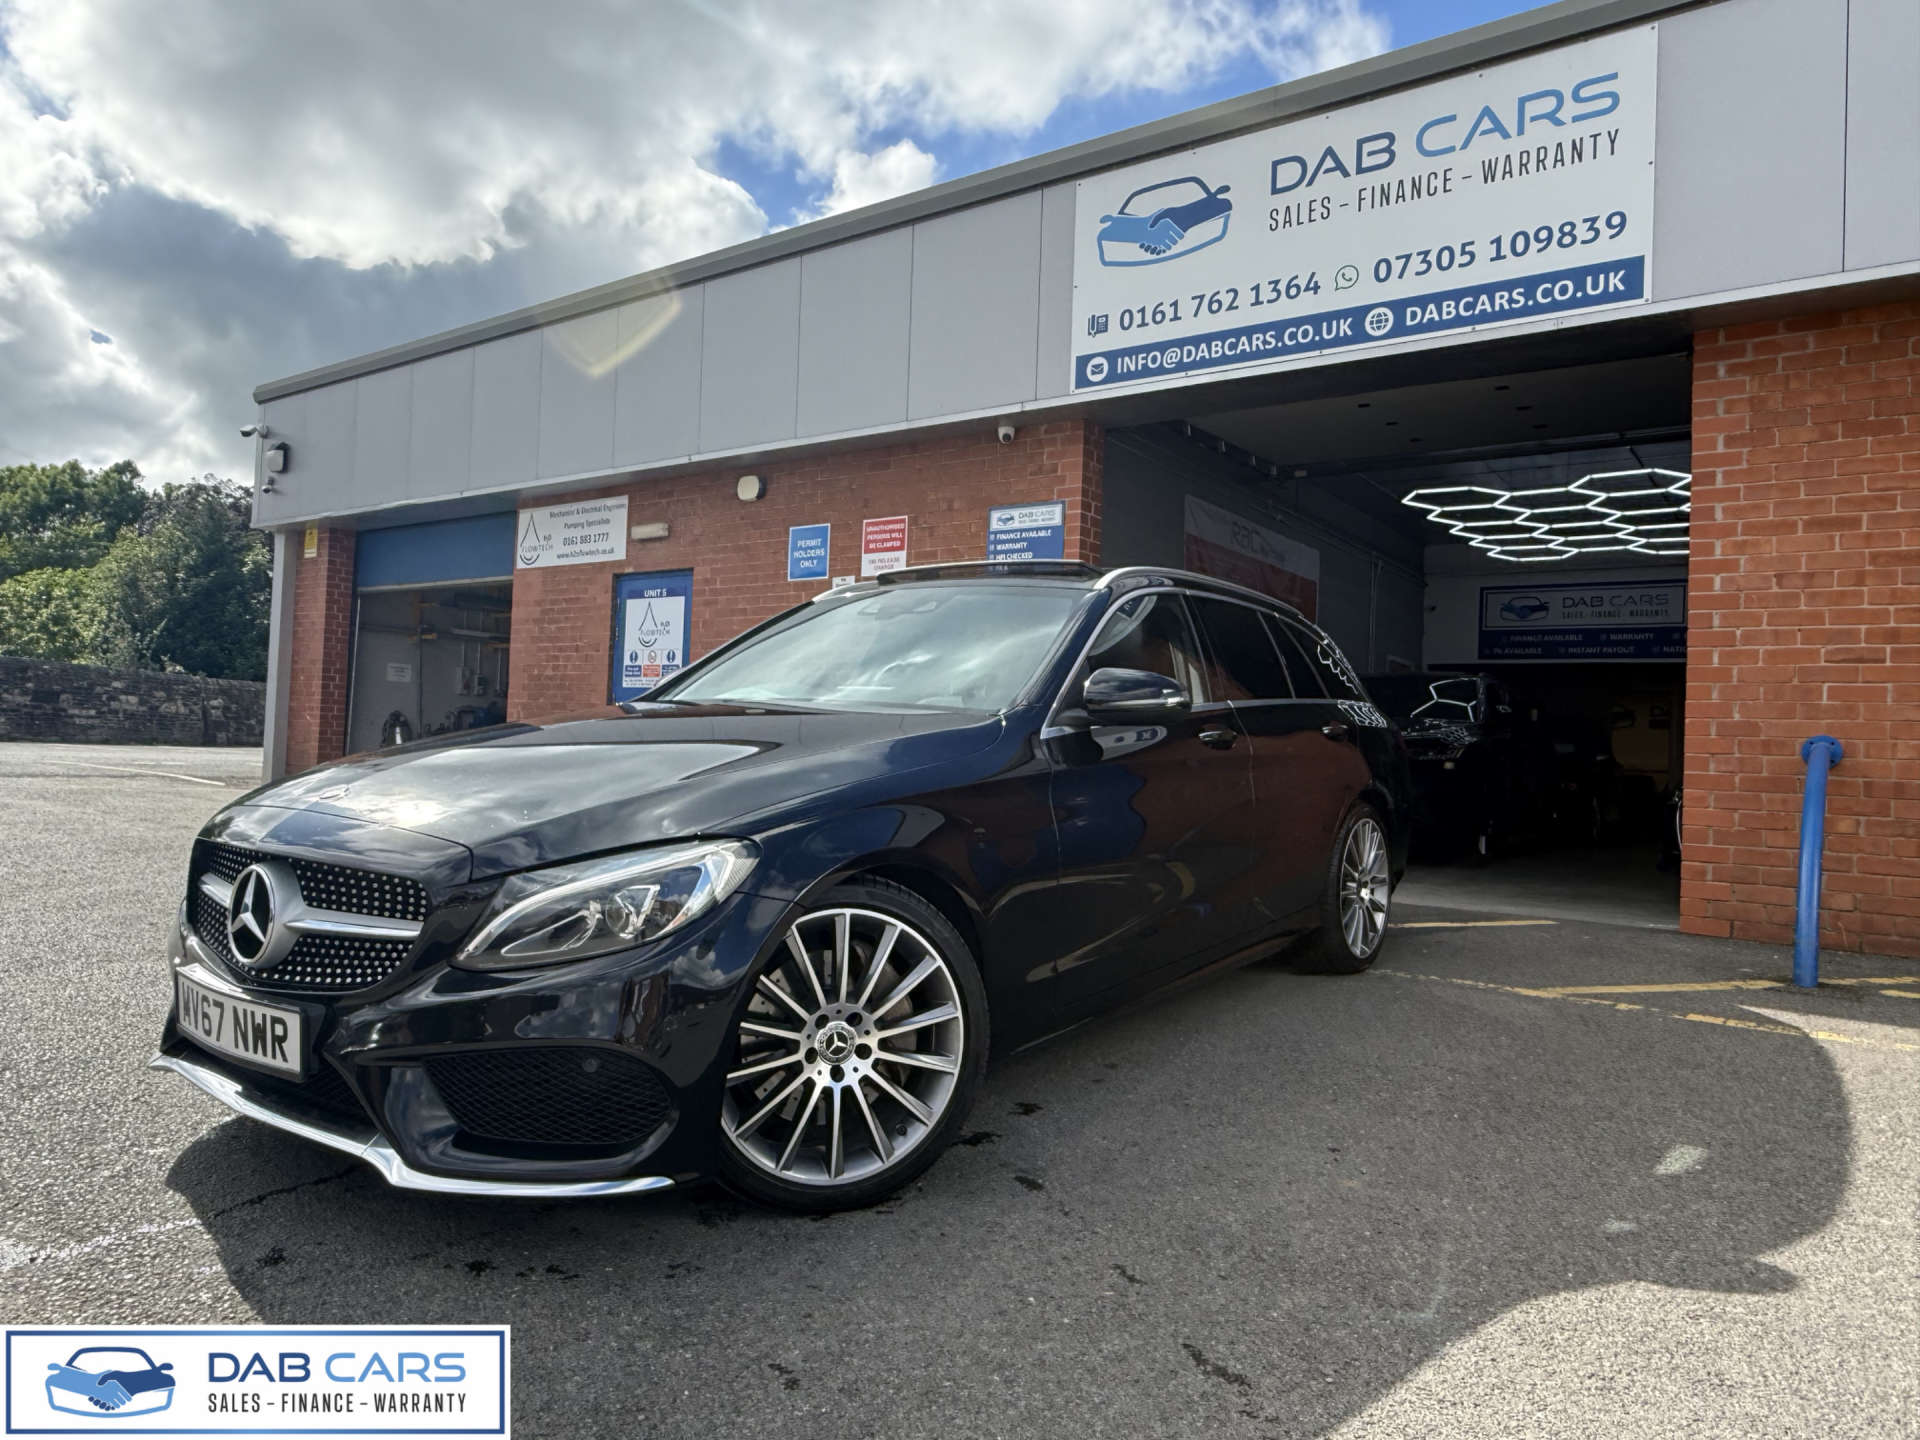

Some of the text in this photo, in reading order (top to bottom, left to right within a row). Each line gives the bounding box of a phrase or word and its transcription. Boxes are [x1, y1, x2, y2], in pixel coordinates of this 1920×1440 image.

[1270, 71, 1621, 196] DAB CARS
[1269, 195, 1332, 232] SALES
[1357, 167, 1453, 213] FINANCE
[1481, 128, 1621, 185] WARRANTY
[1373, 210, 1627, 285] 07305 109839
[1119, 271, 1321, 332] 0161 762 1364
[1404, 269, 1625, 327] DABCARS.CO.UK
[1116, 316, 1353, 375] INFO@DABCARS.CO.UK
[793, 548, 825, 558] HOLDERS
[797, 538, 822, 547] PERMIT
[800, 559, 817, 568] ONLY
[1562, 593, 1670, 609] DAB CARS
[232, 1005, 289, 1063] NWR
